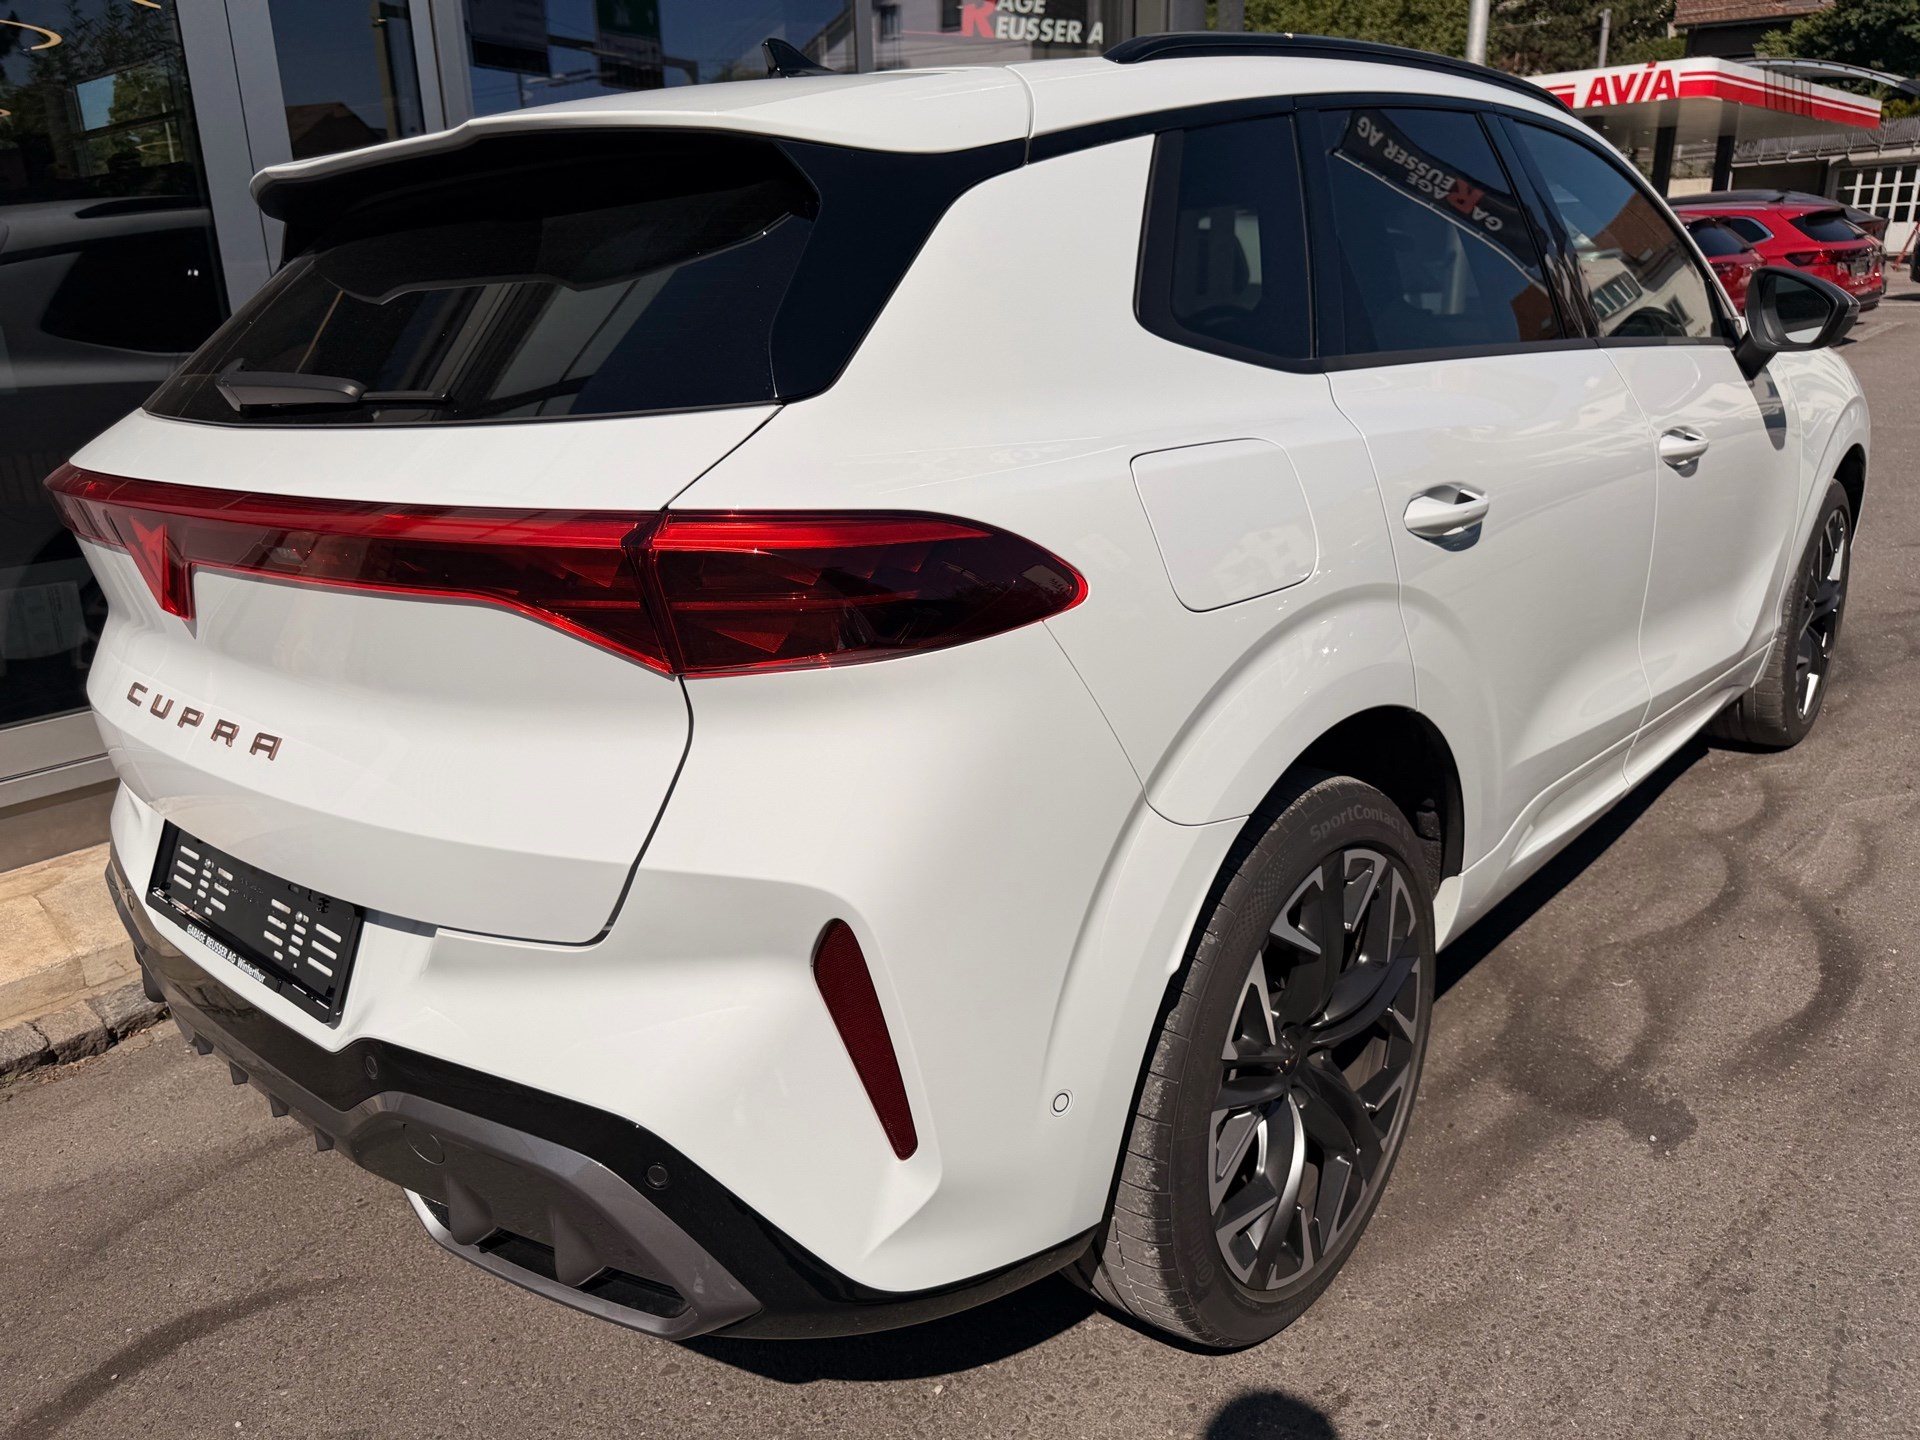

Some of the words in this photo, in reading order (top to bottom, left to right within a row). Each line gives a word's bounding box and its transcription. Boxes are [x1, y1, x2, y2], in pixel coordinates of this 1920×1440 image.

[1585, 61, 1677, 107] AVIA
[1357, 116, 1384, 147] AG
[127, 682, 282, 761] CUPRA
[1310, 804, 1401, 843] SportContact
[187, 924, 206, 943] GARAGE
[205, 936, 228, 958] REUSSER
[226, 951, 237, 964] AG
[237, 957, 266, 983] Winterthur
